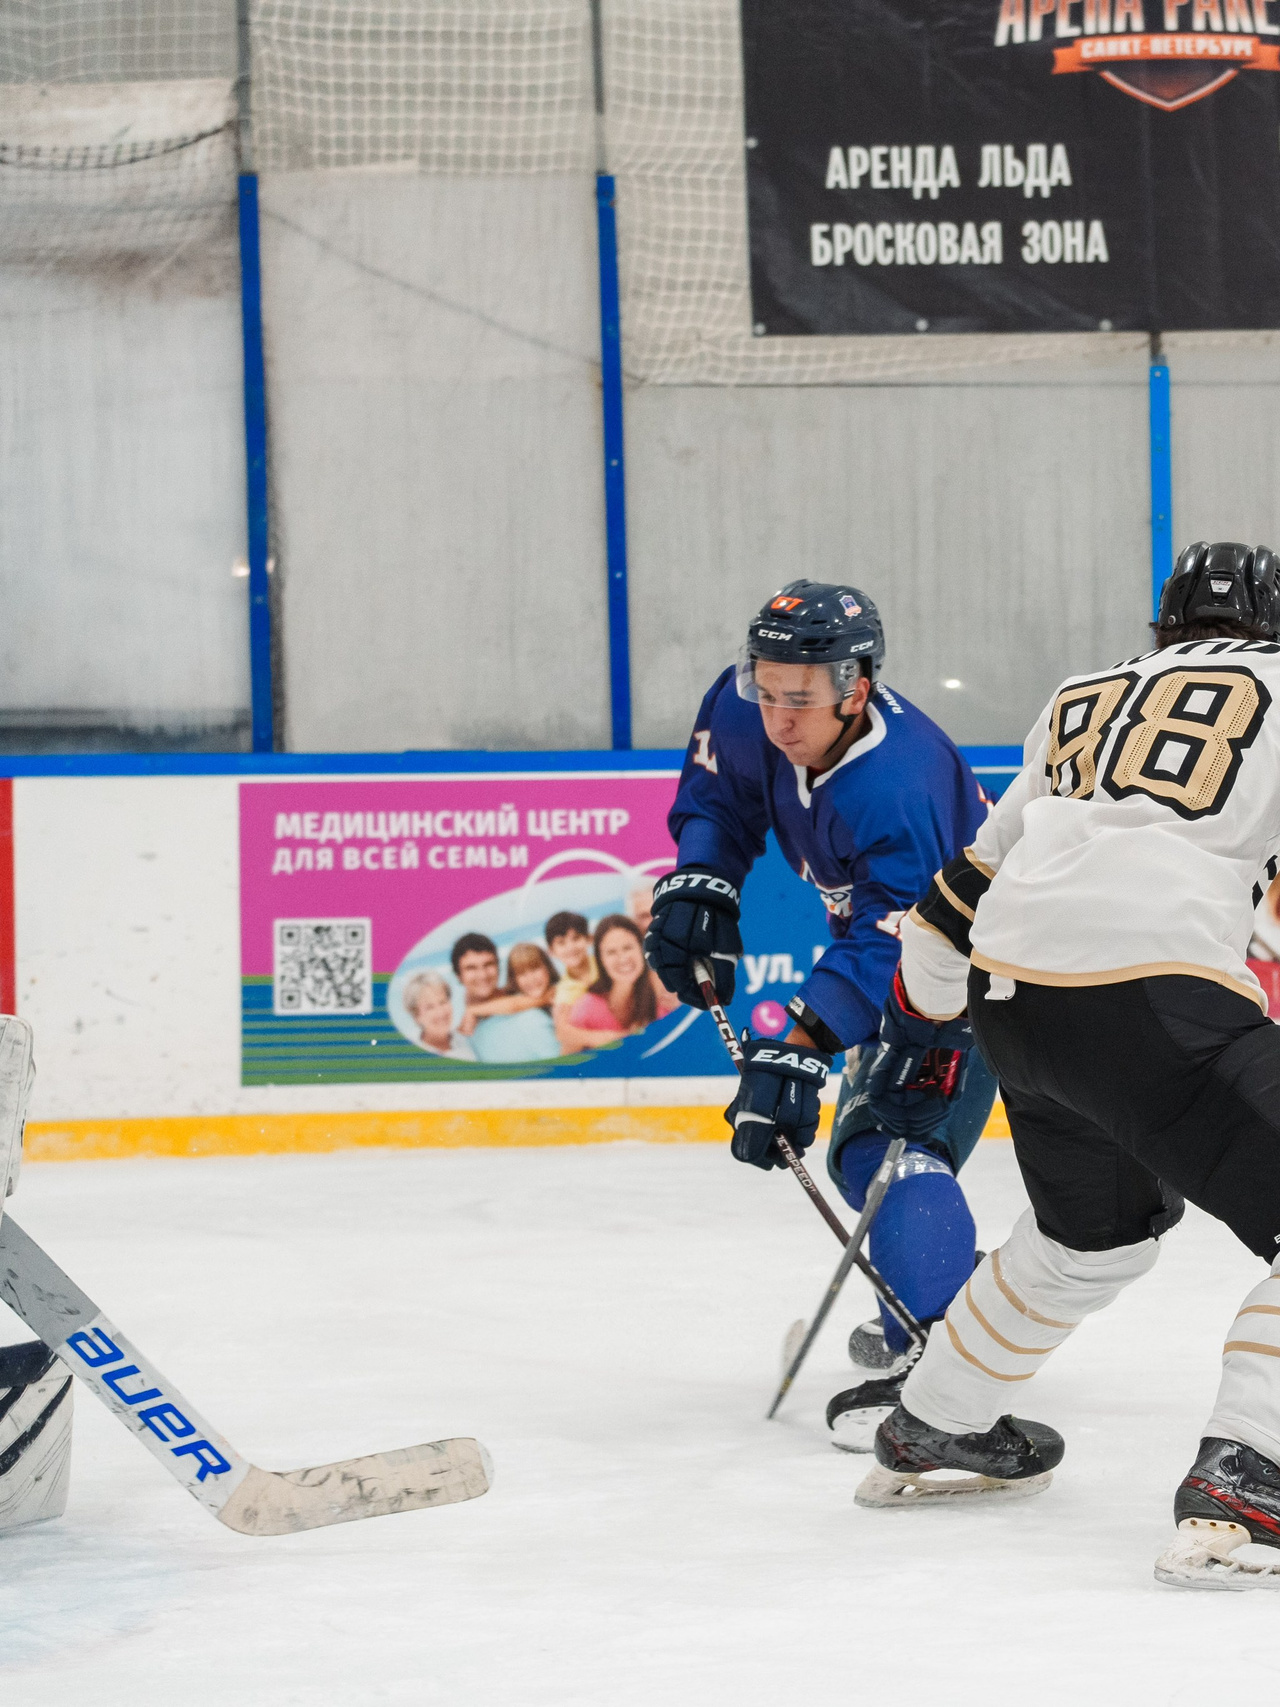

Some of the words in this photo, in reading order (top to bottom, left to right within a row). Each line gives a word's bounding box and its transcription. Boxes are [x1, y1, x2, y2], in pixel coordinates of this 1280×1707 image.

[825, 145, 960, 200] АРЕНДА
[978, 143, 1072, 199] ЛЬДА
[810, 221, 1003, 267] БРОСКОВАЯ
[1021, 219, 1109, 264] ЗОНА
[758, 628, 793, 641] CCM
[850, 640, 874, 653] CCM
[1045, 665, 1272, 821] 88
[275, 803, 519, 844] МЕДИЦИНСКИЙ
[527, 808, 630, 842] ЦЕНТР
[272, 847, 334, 876] ДЛЯ
[342, 841, 420, 870] ВСЕЙ
[428, 845, 529, 870] СЕМЬИ
[744, 954, 804, 994] ул.
[710, 1004, 744, 1062] CCM
